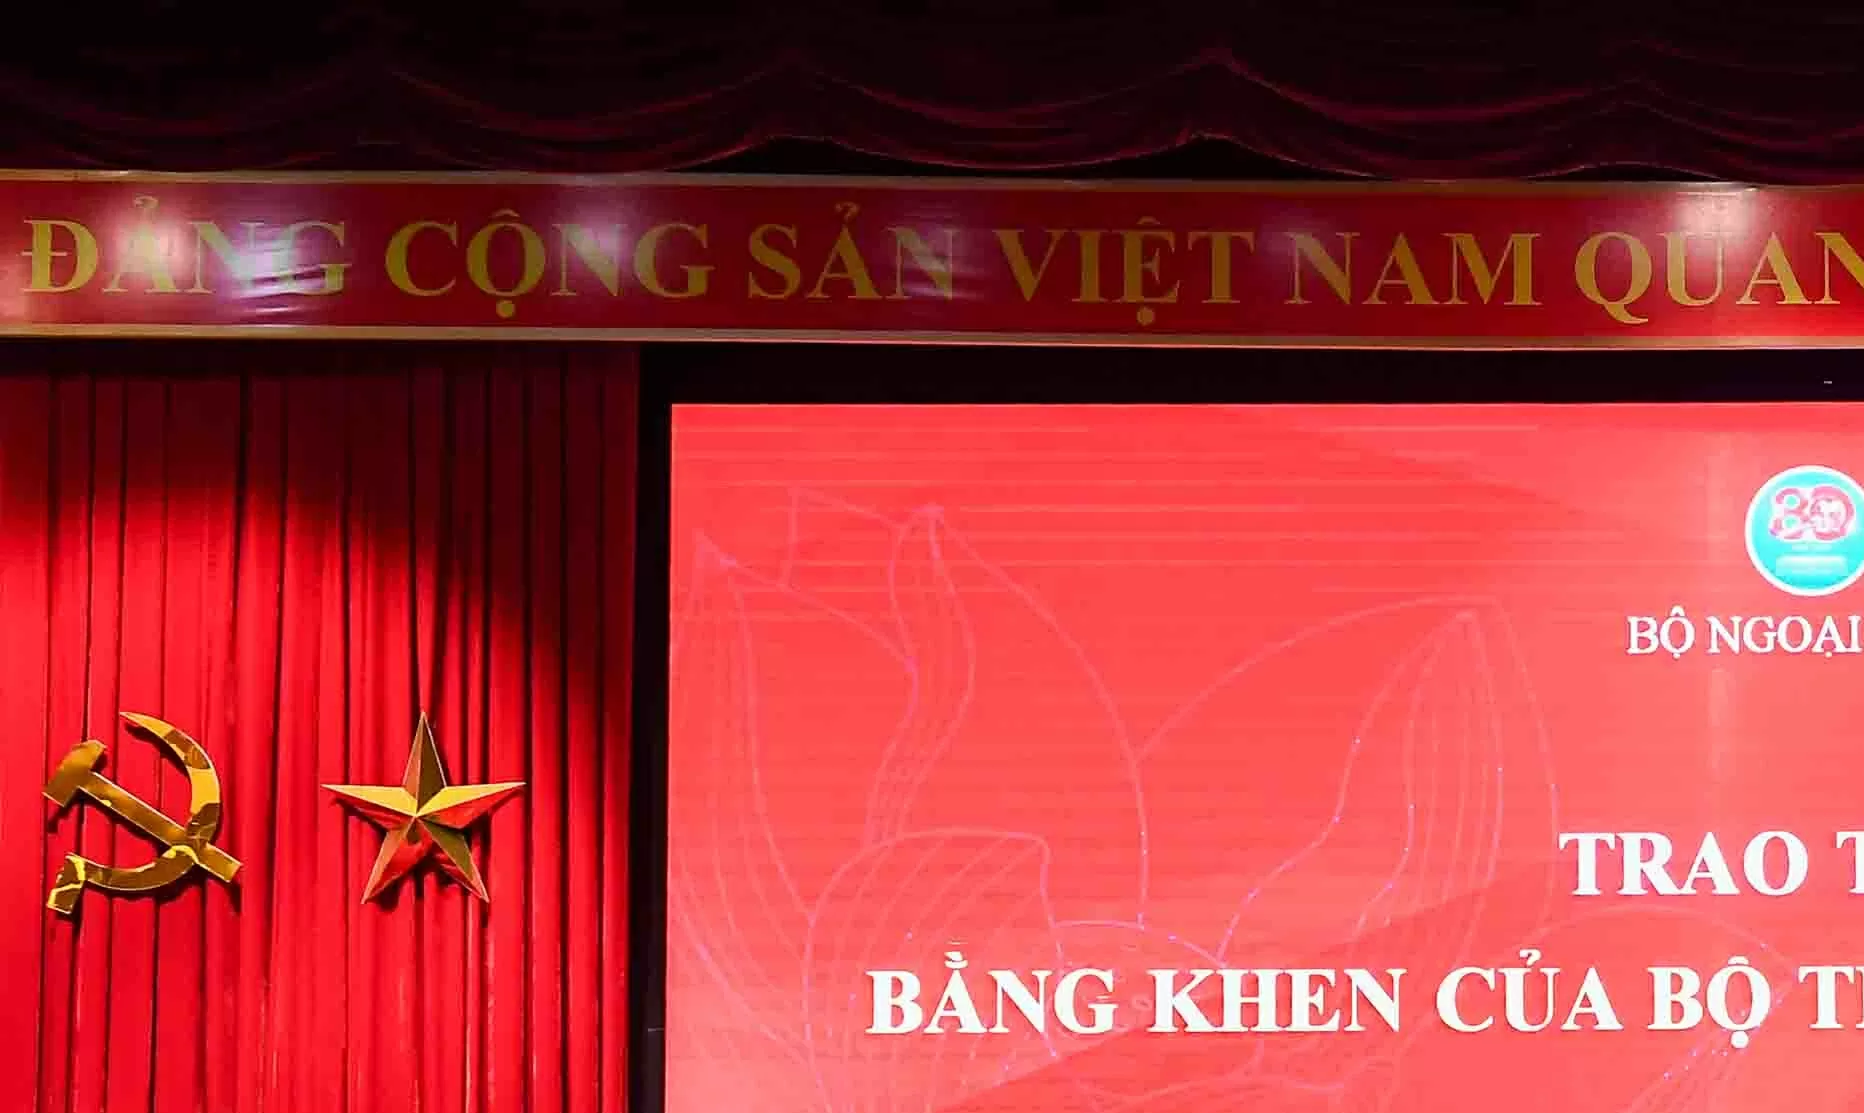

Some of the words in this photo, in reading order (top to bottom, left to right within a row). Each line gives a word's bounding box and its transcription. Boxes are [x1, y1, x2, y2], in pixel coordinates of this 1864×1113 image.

[21, 195, 349, 298] ĐẢNG
[386, 208, 711, 318] CỘNG
[747, 202, 956, 303] SẢN
[994, 216, 1255, 326] VIỆT
[1291, 231, 1543, 307] NAM
[1626, 605, 1695, 659] BỘ
[1706, 615, 1862, 658] NGOẠI
[1558, 830, 1809, 896] TRAO
[865, 948, 1118, 1034] BẰNG
[1148, 968, 1407, 1033] KHEN
[1436, 949, 1623, 1032] CỦA
[1647, 956, 1771, 1049] BỘ
